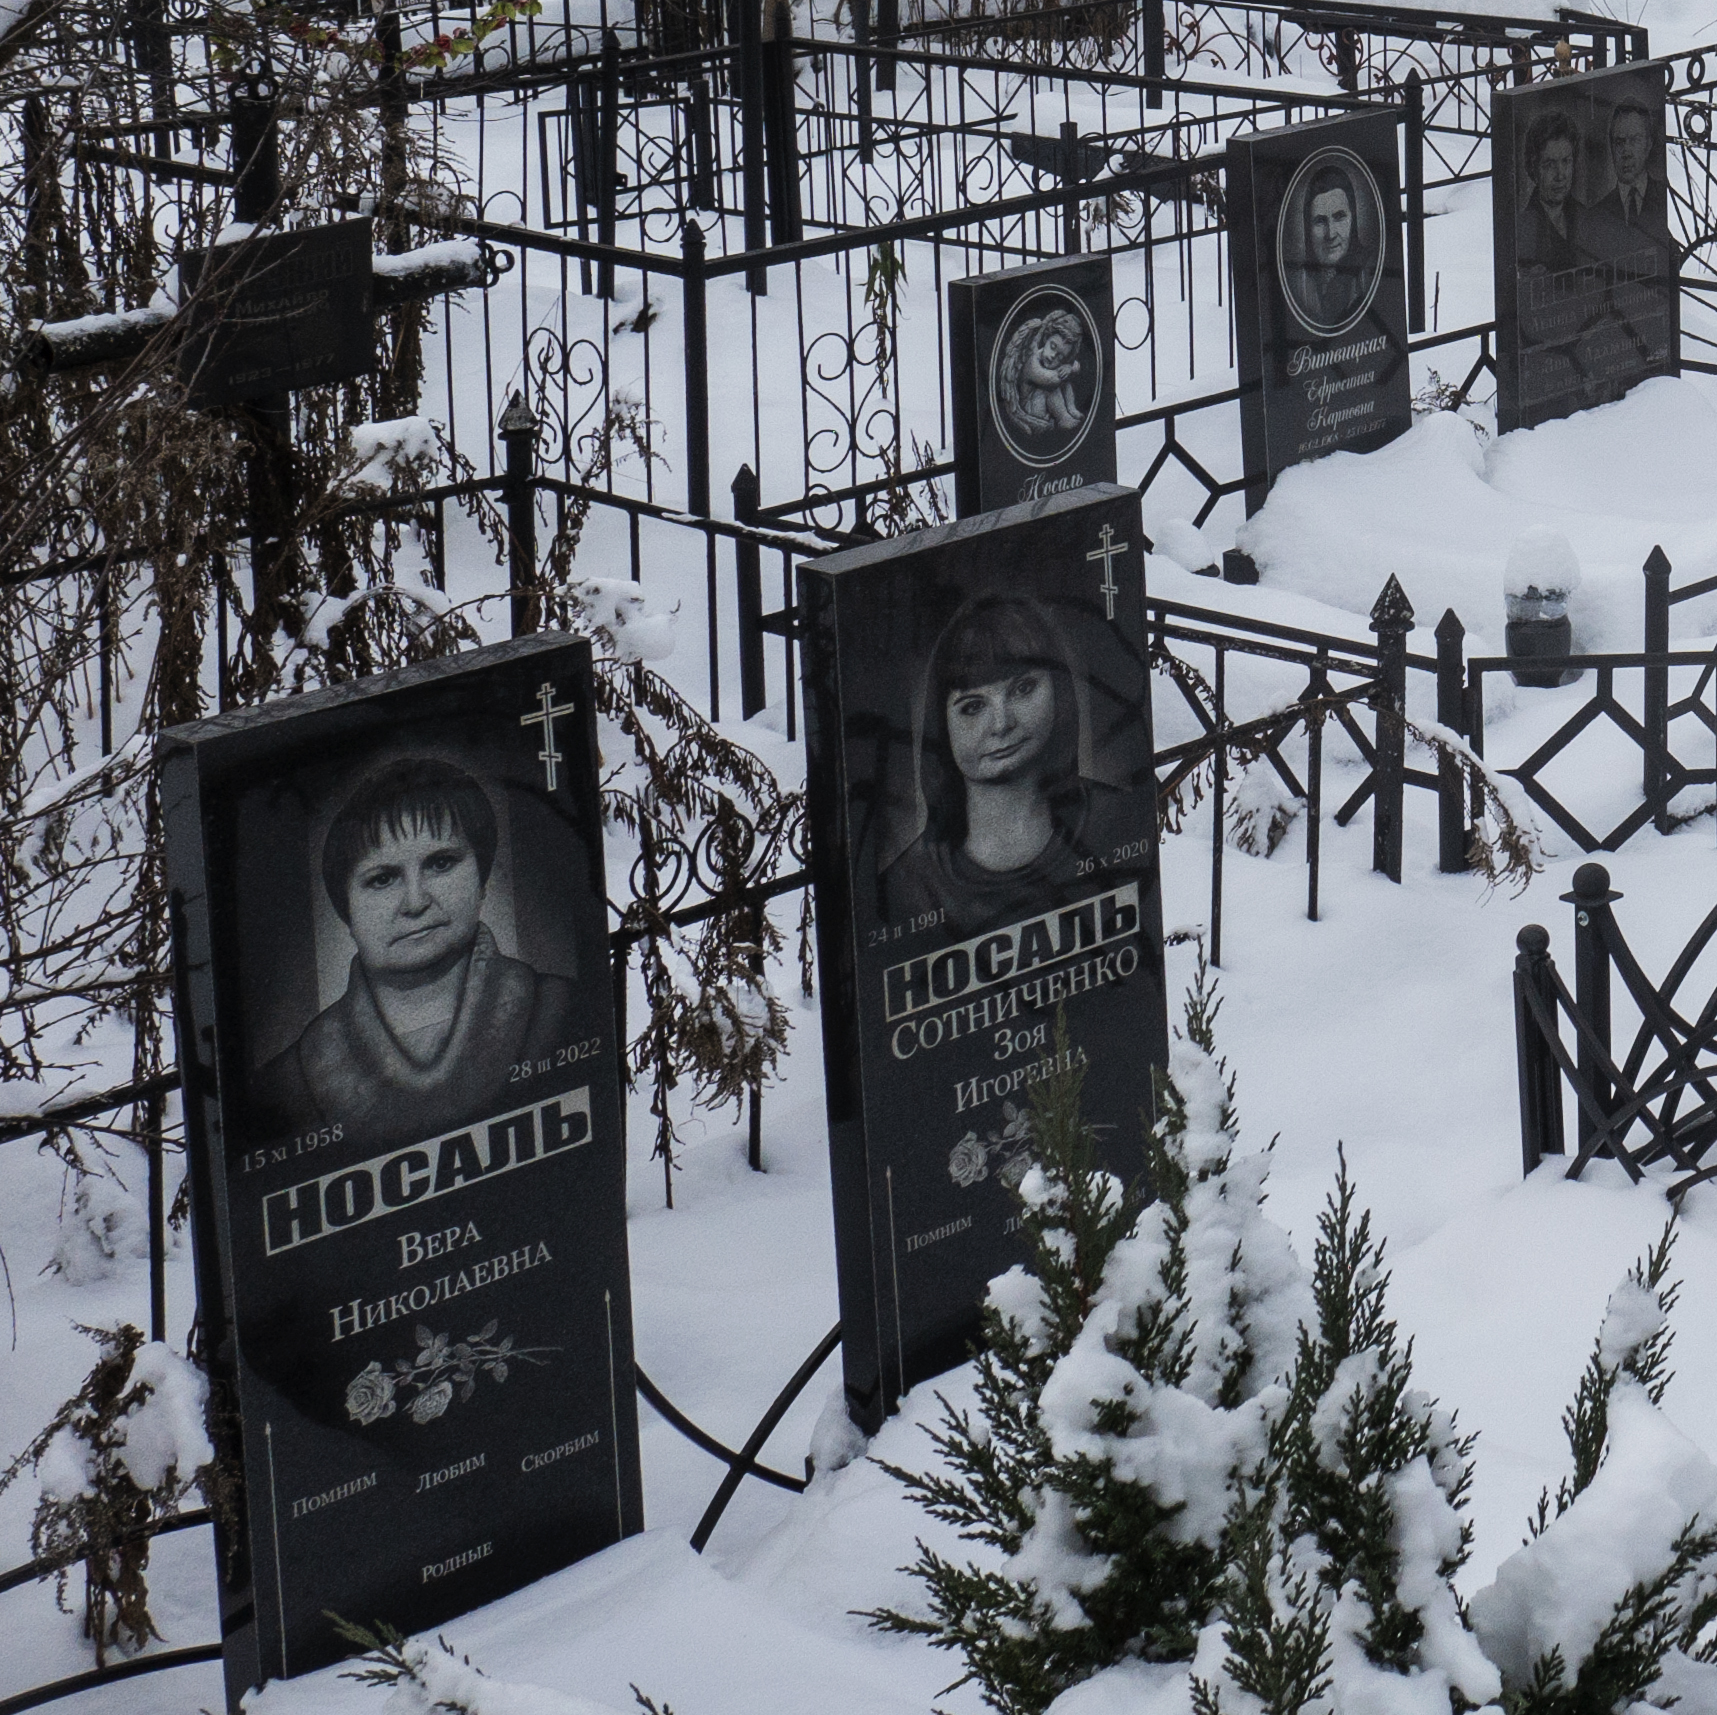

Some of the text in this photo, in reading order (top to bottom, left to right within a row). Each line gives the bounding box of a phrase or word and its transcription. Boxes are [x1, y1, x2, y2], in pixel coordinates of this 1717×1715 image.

[1286, 334, 1388, 376] Витвицкая
[1307, 400, 1375, 431] Карповна
[1018, 471, 1084, 502] Носаль
[1076, 856, 1096, 877] 26
[1113, 838, 1150, 865] 2020
[868, 927, 888, 948] 24
[909, 908, 947, 935] 1991
[885, 888, 1139, 1020] НОСАЛЬ
[509, 1064, 533, 1083] 28
[556, 1037, 602, 1067] 2022
[242, 1148, 266, 1173] 15
[294, 1123, 344, 1156] 1958
[264, 1095, 590, 1254] НОСАЛЬ
